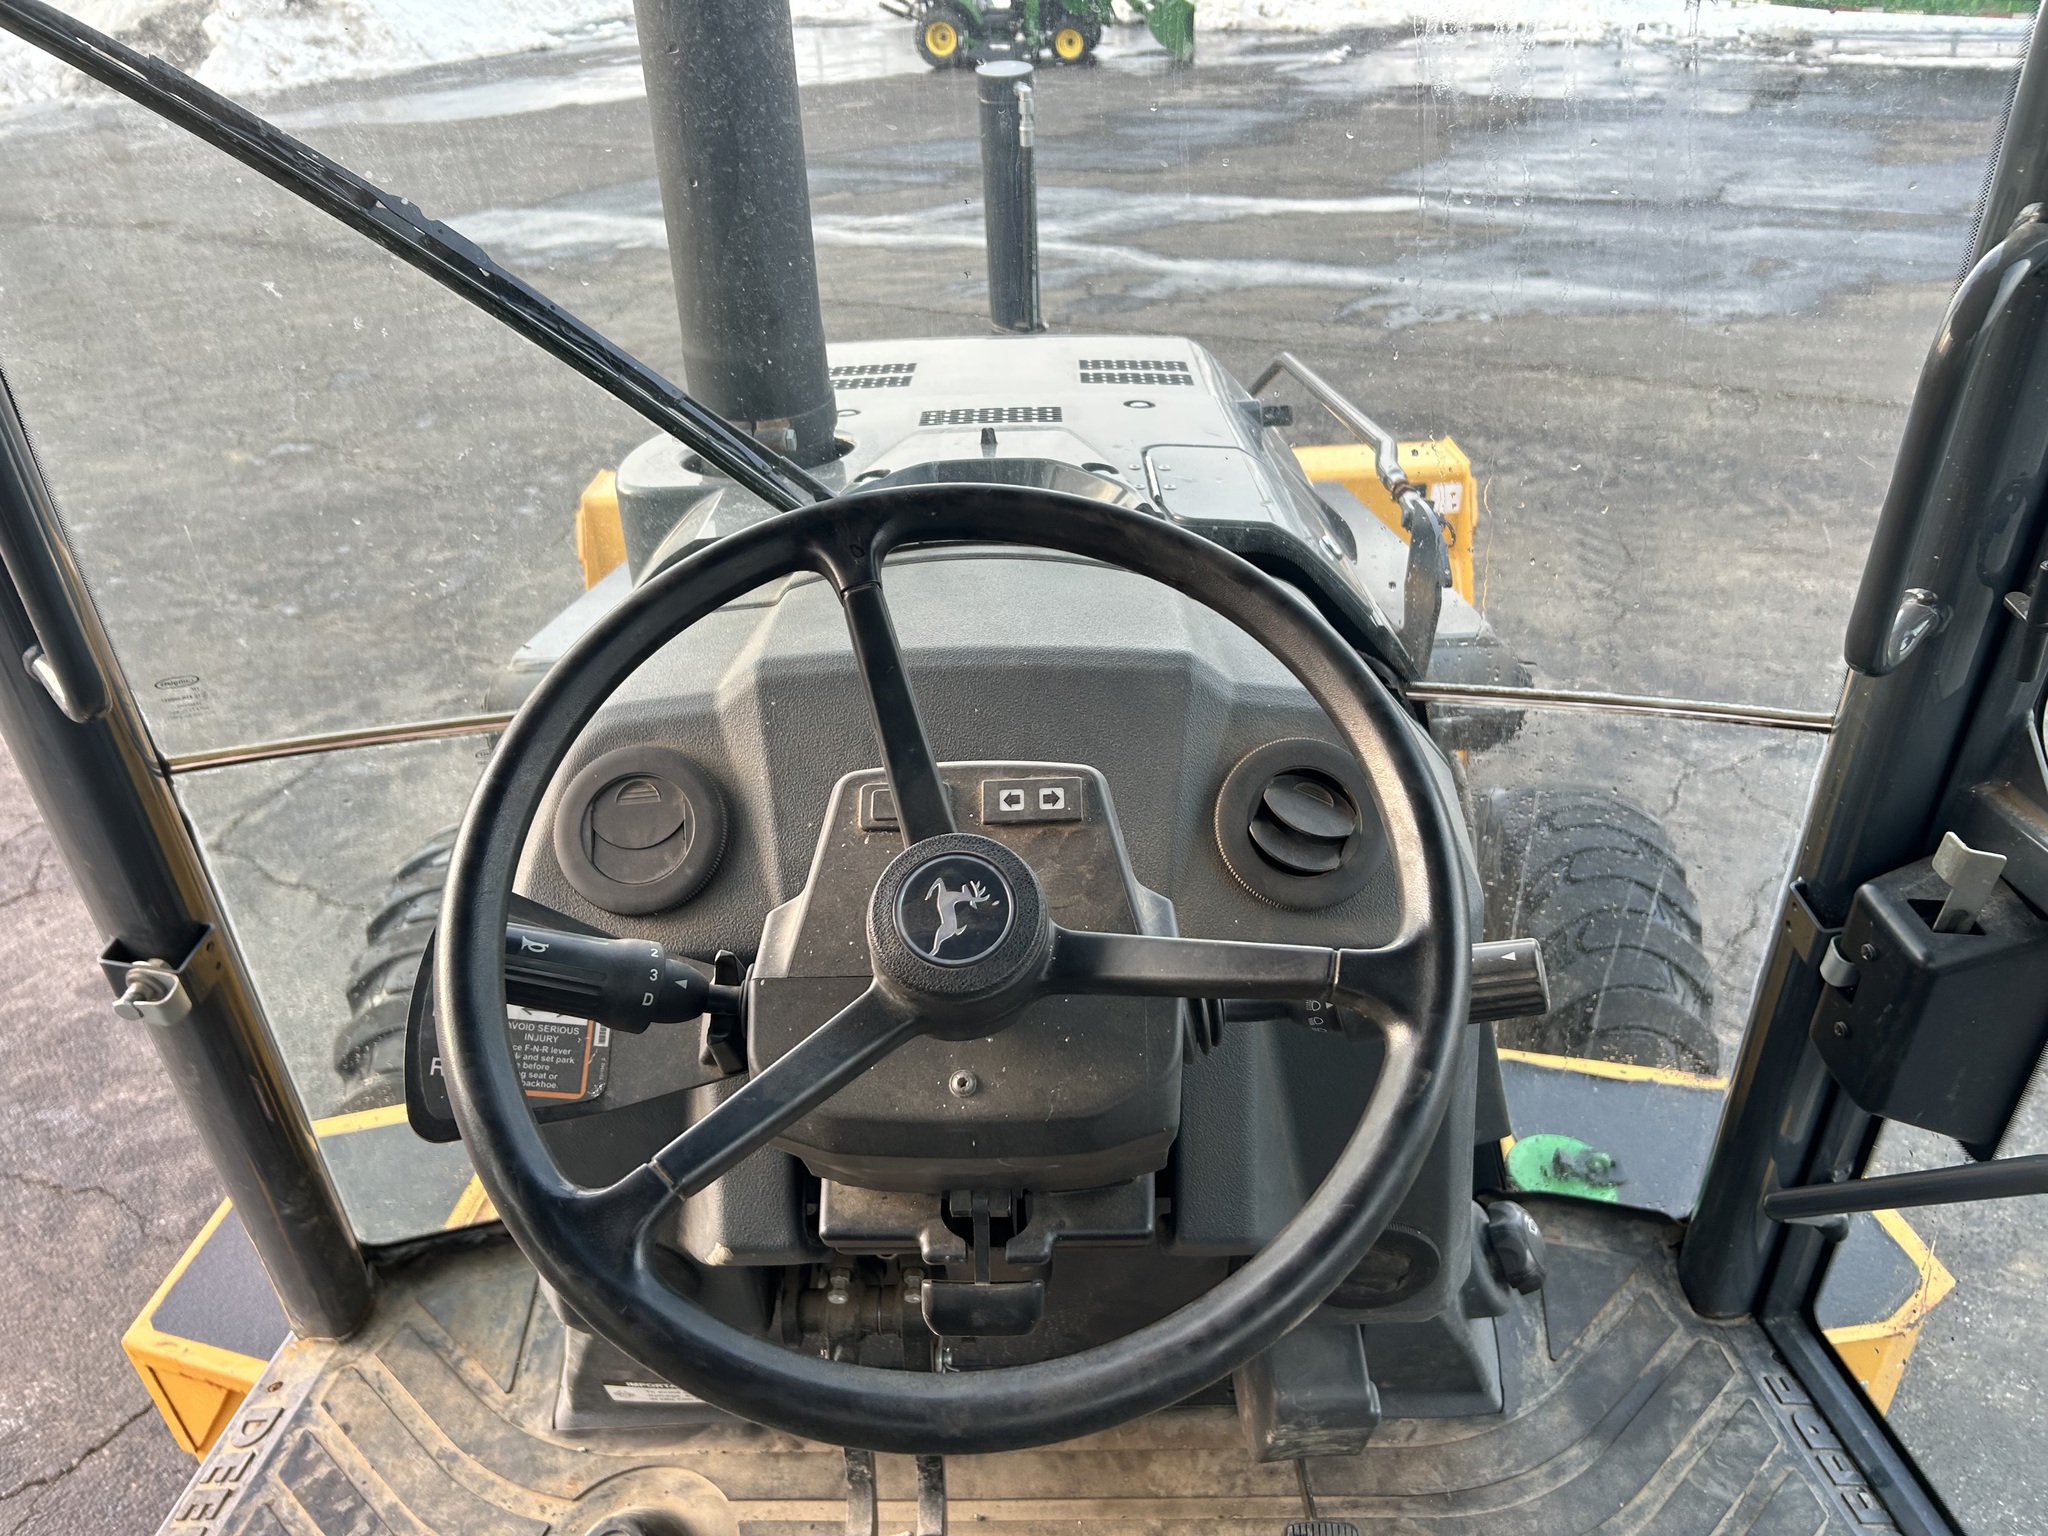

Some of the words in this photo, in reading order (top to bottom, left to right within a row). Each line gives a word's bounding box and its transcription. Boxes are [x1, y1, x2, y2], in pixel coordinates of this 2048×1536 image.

[650, 948, 659, 958] 2
[649, 968, 658, 981] 3
[642, 992, 654, 1006] D
[537, 1024, 580, 1035] SERIOUS
[524, 1033, 559, 1043] INJURY
[524, 1044, 549, 1053] F-N-R
[550, 1046, 572, 1055] lever
[522, 1053, 539, 1061] and
[541, 1055, 555, 1063] set
[556, 1056, 575, 1065] park
[522, 1062, 550, 1071] before
[528, 1072, 547, 1080] seat
[625, 1381, 678, 1389] IMPORTA
[172, 1406, 285, 1536] DEE
